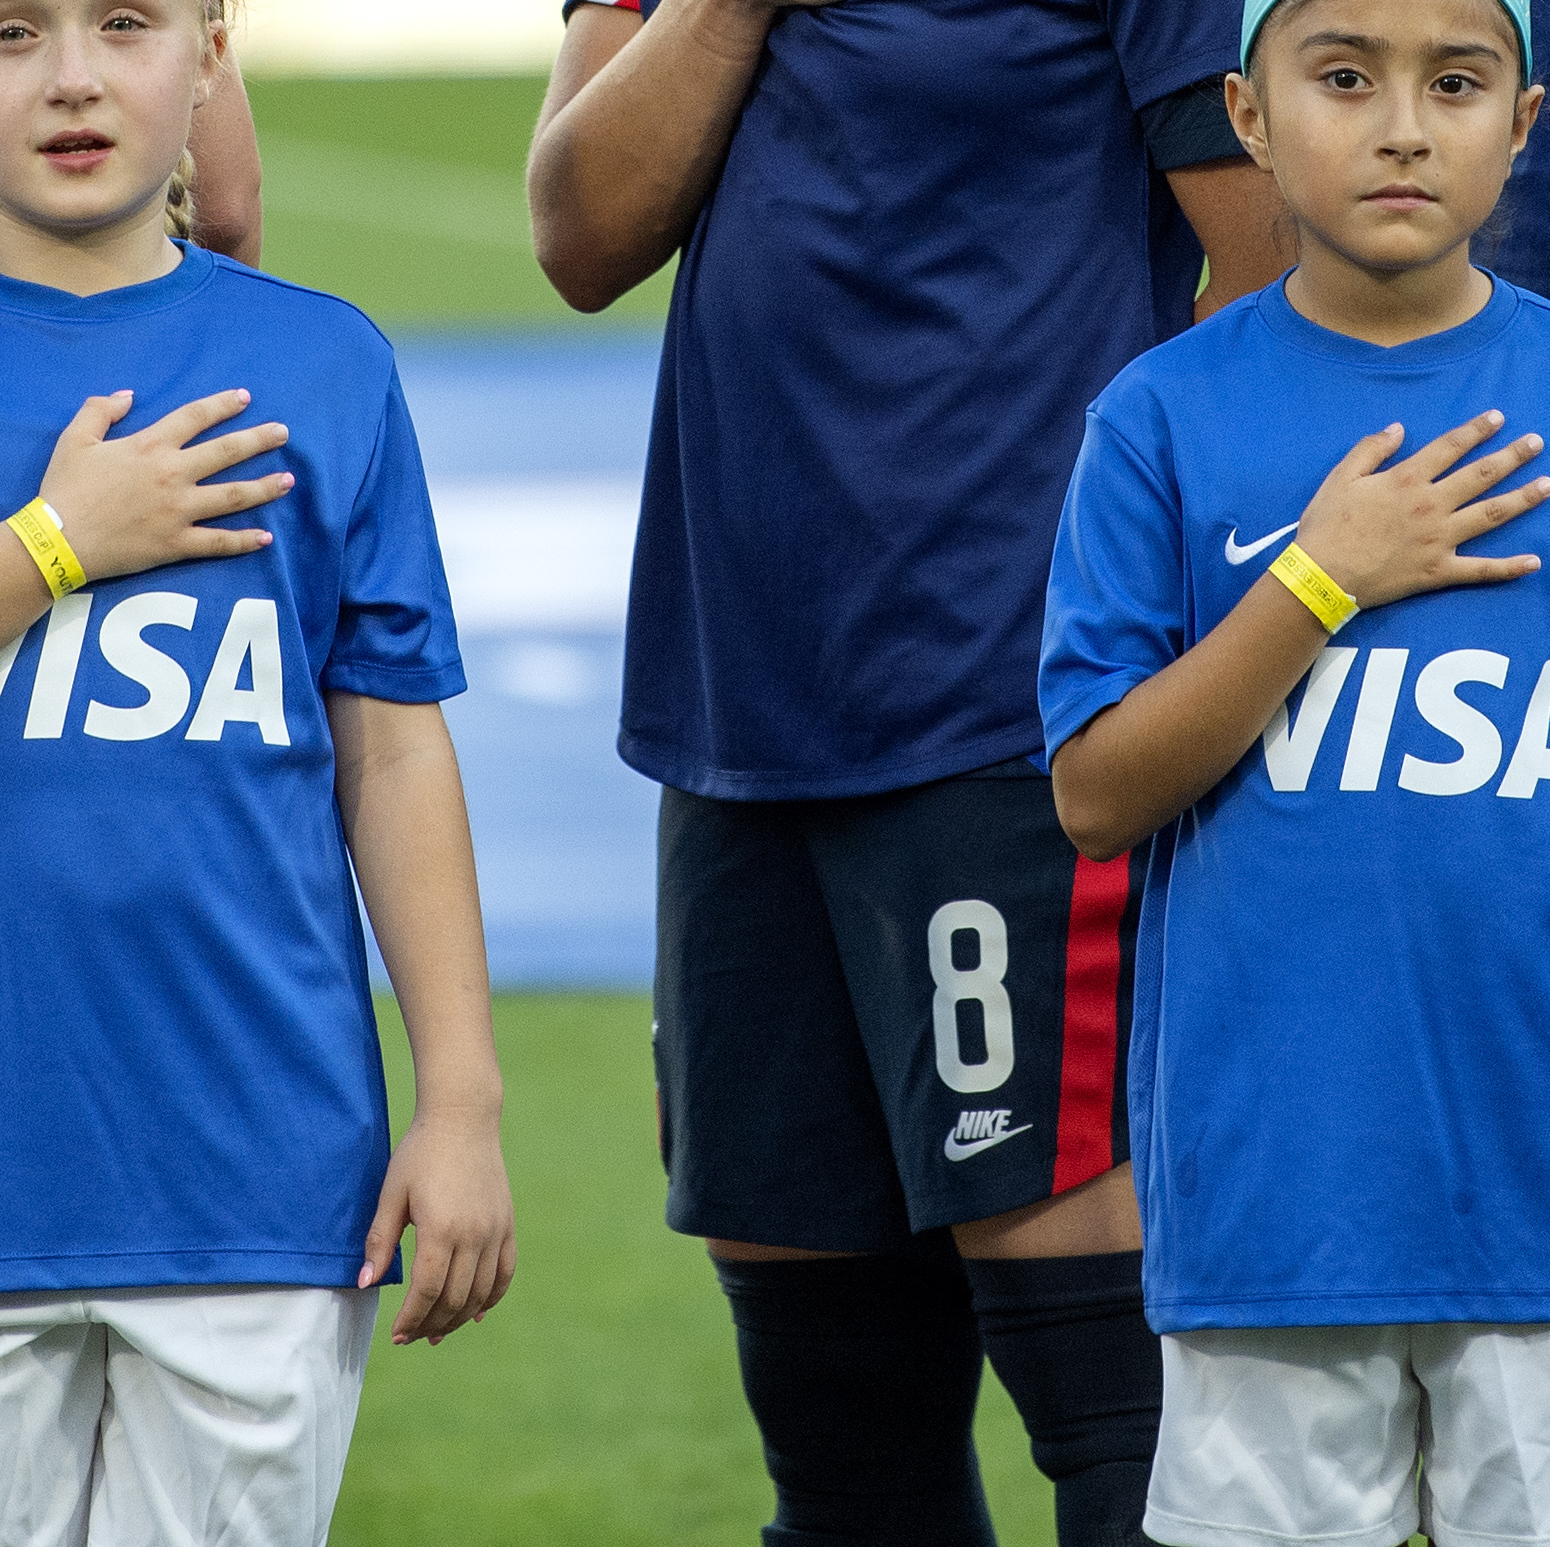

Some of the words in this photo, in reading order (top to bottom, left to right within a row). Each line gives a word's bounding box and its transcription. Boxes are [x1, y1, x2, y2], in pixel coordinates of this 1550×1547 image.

[50, 556, 76, 595] YOUT
[928, 899, 1015, 1094] 8
[955, 1109, 1012, 1140] NIKE
